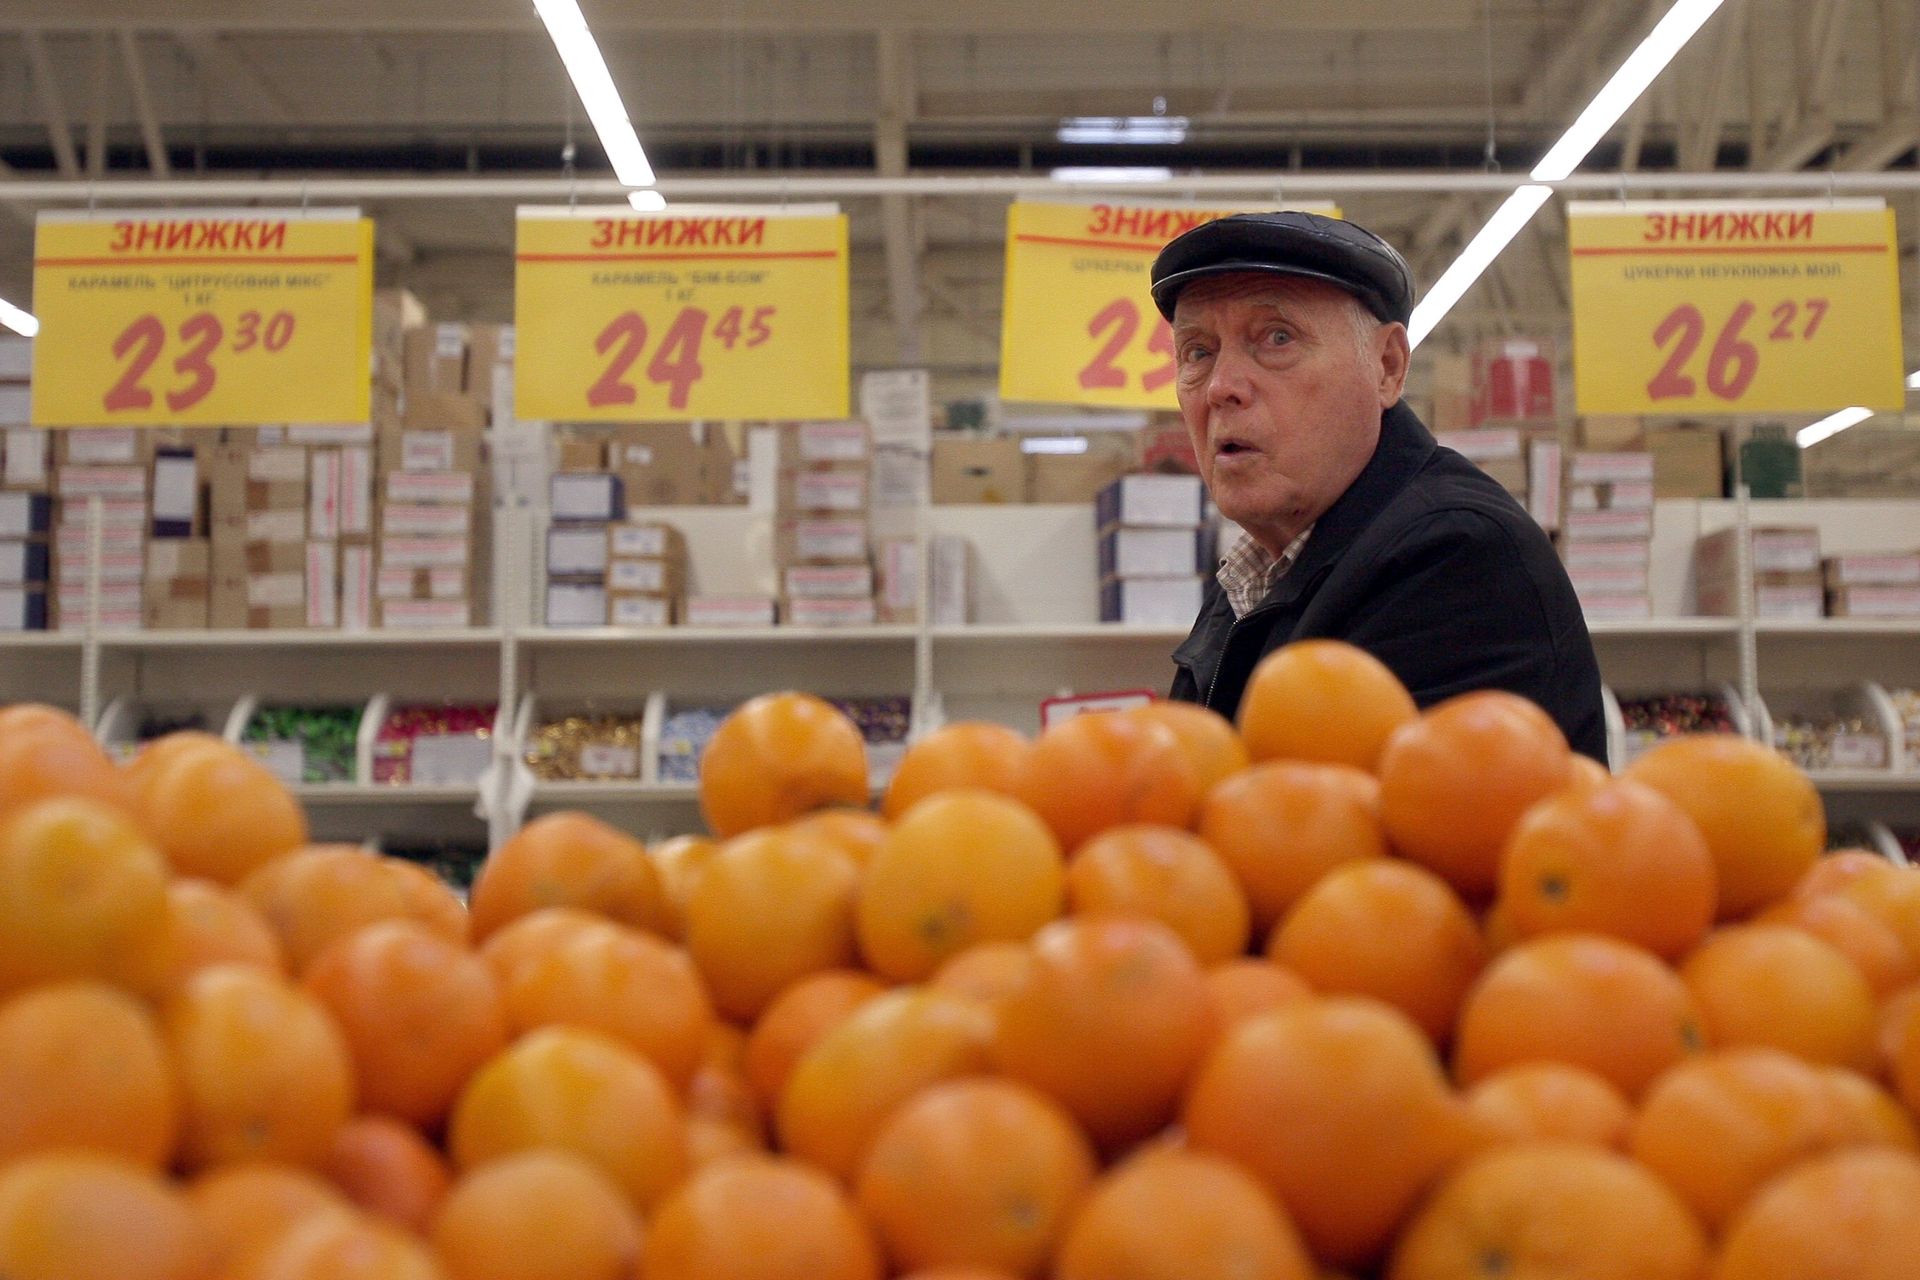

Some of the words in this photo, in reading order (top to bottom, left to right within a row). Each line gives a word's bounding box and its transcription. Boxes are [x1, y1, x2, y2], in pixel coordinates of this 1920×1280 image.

[110, 219, 287, 252] ЗНИЖКИ
[590, 217, 767, 249] ЗНИЖКИ
[1644, 211, 1815, 243] ЗНИЖКИ
[68, 275, 156, 290] КАРАМЕЛЬ
[591, 270, 678, 285] КАРАМЕЛЬ
[1624, 265, 1695, 280] ЦУКЕРКИ
